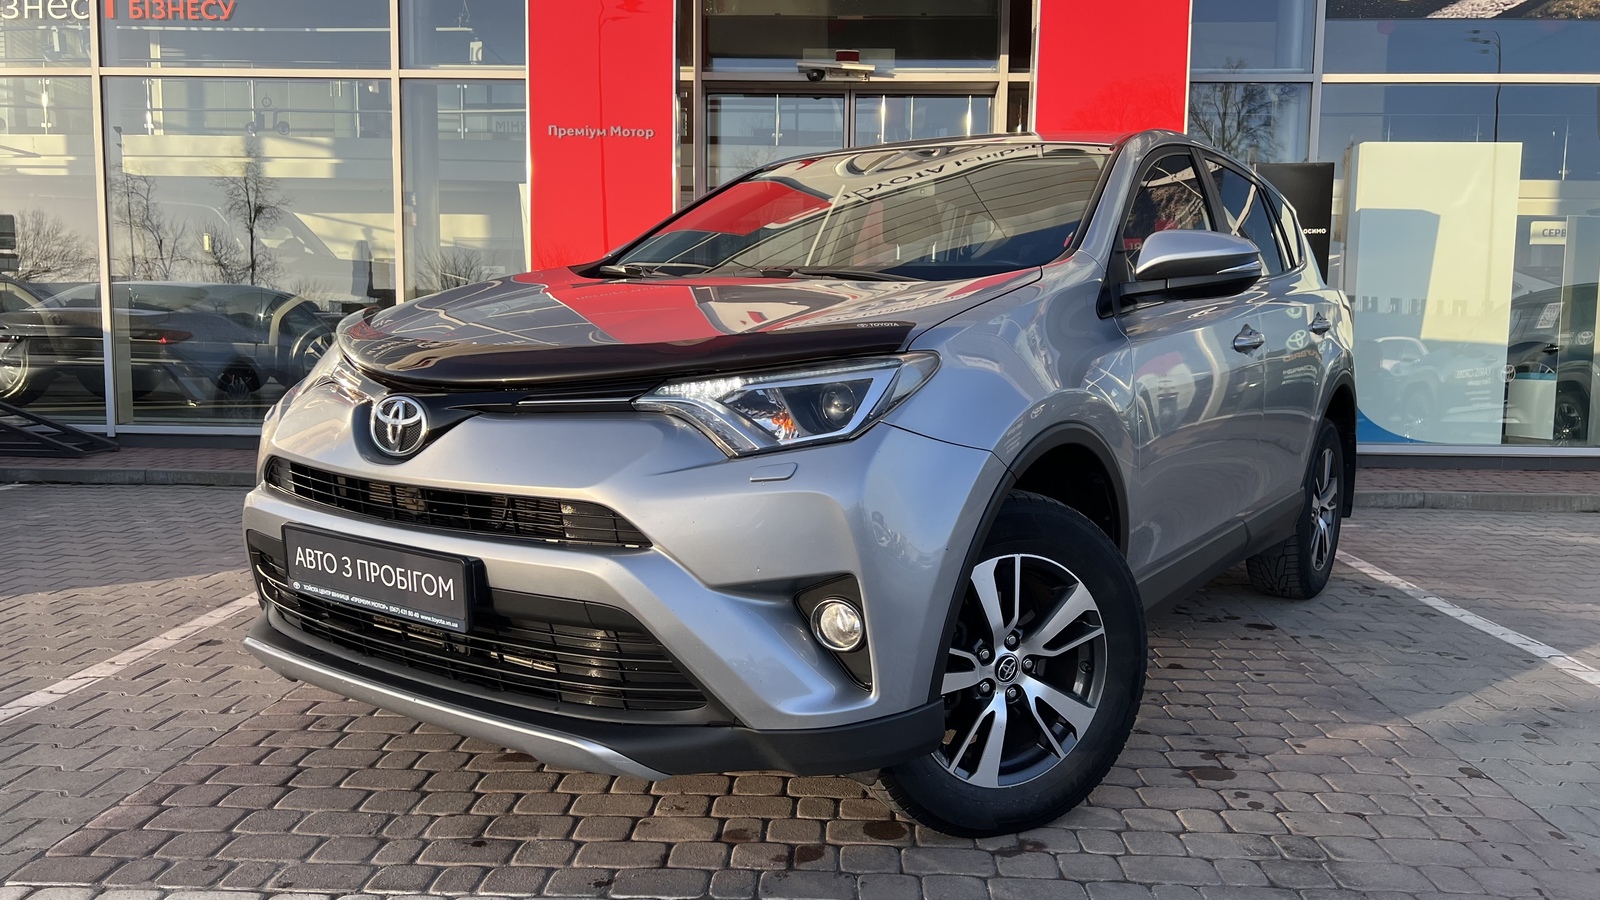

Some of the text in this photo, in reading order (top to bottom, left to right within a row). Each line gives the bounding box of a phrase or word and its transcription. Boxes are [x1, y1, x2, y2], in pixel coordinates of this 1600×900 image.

[128, 0, 235, 20] БІЗНЕСУ
[548, 124, 655, 140] Преміум Мотор
[295, 546, 338, 574] АВТО
[356, 558, 455, 601] ПРОБІГОМ
